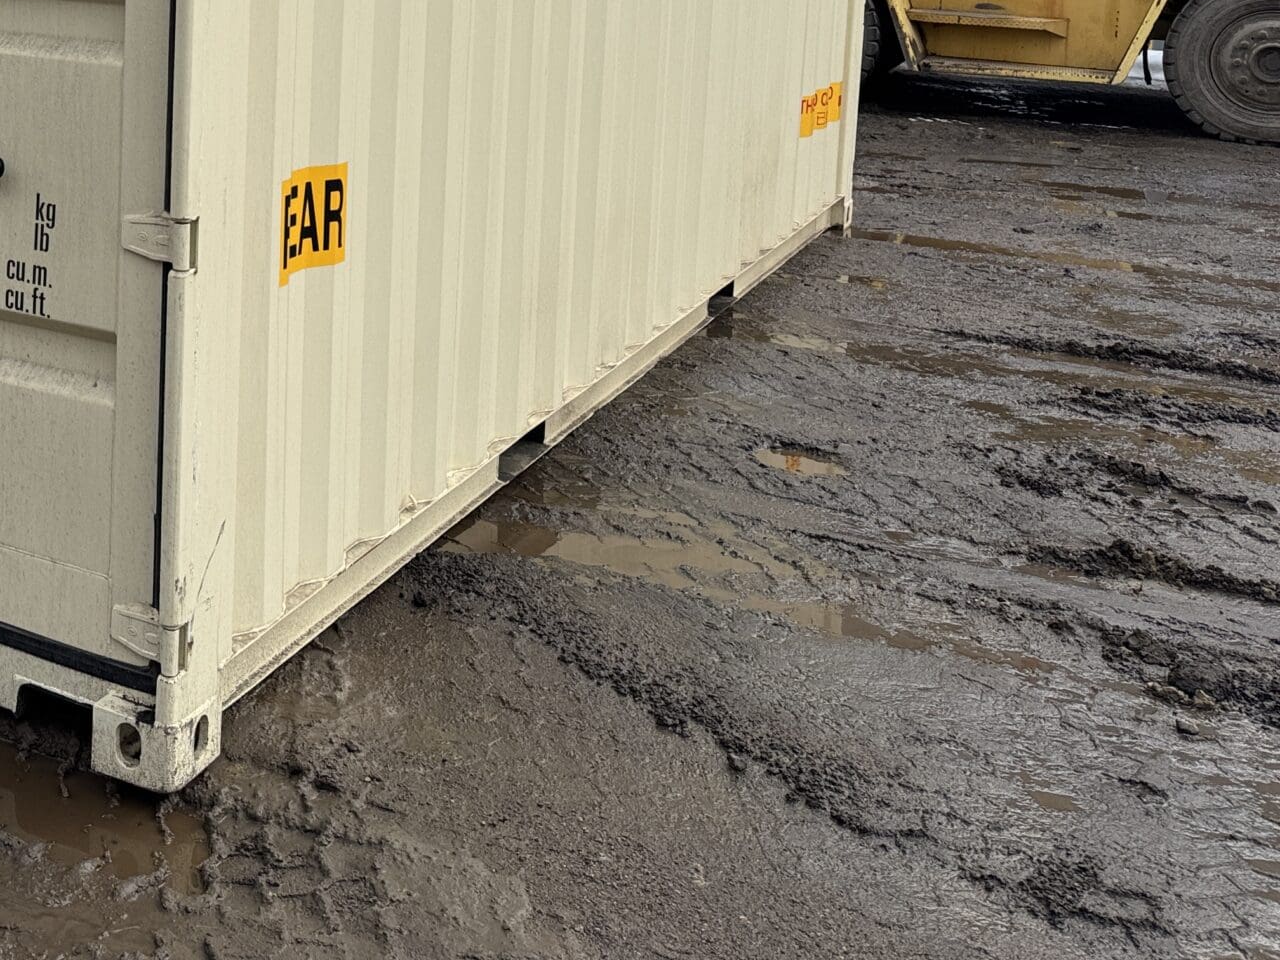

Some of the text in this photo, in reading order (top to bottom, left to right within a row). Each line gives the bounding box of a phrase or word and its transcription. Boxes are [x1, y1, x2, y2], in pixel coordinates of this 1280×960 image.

[35, 193, 56, 228] kg
[33, 223, 50, 252] lb
[6, 259, 53, 288] cu.m.
[5, 288, 51, 319] cu.ft.
